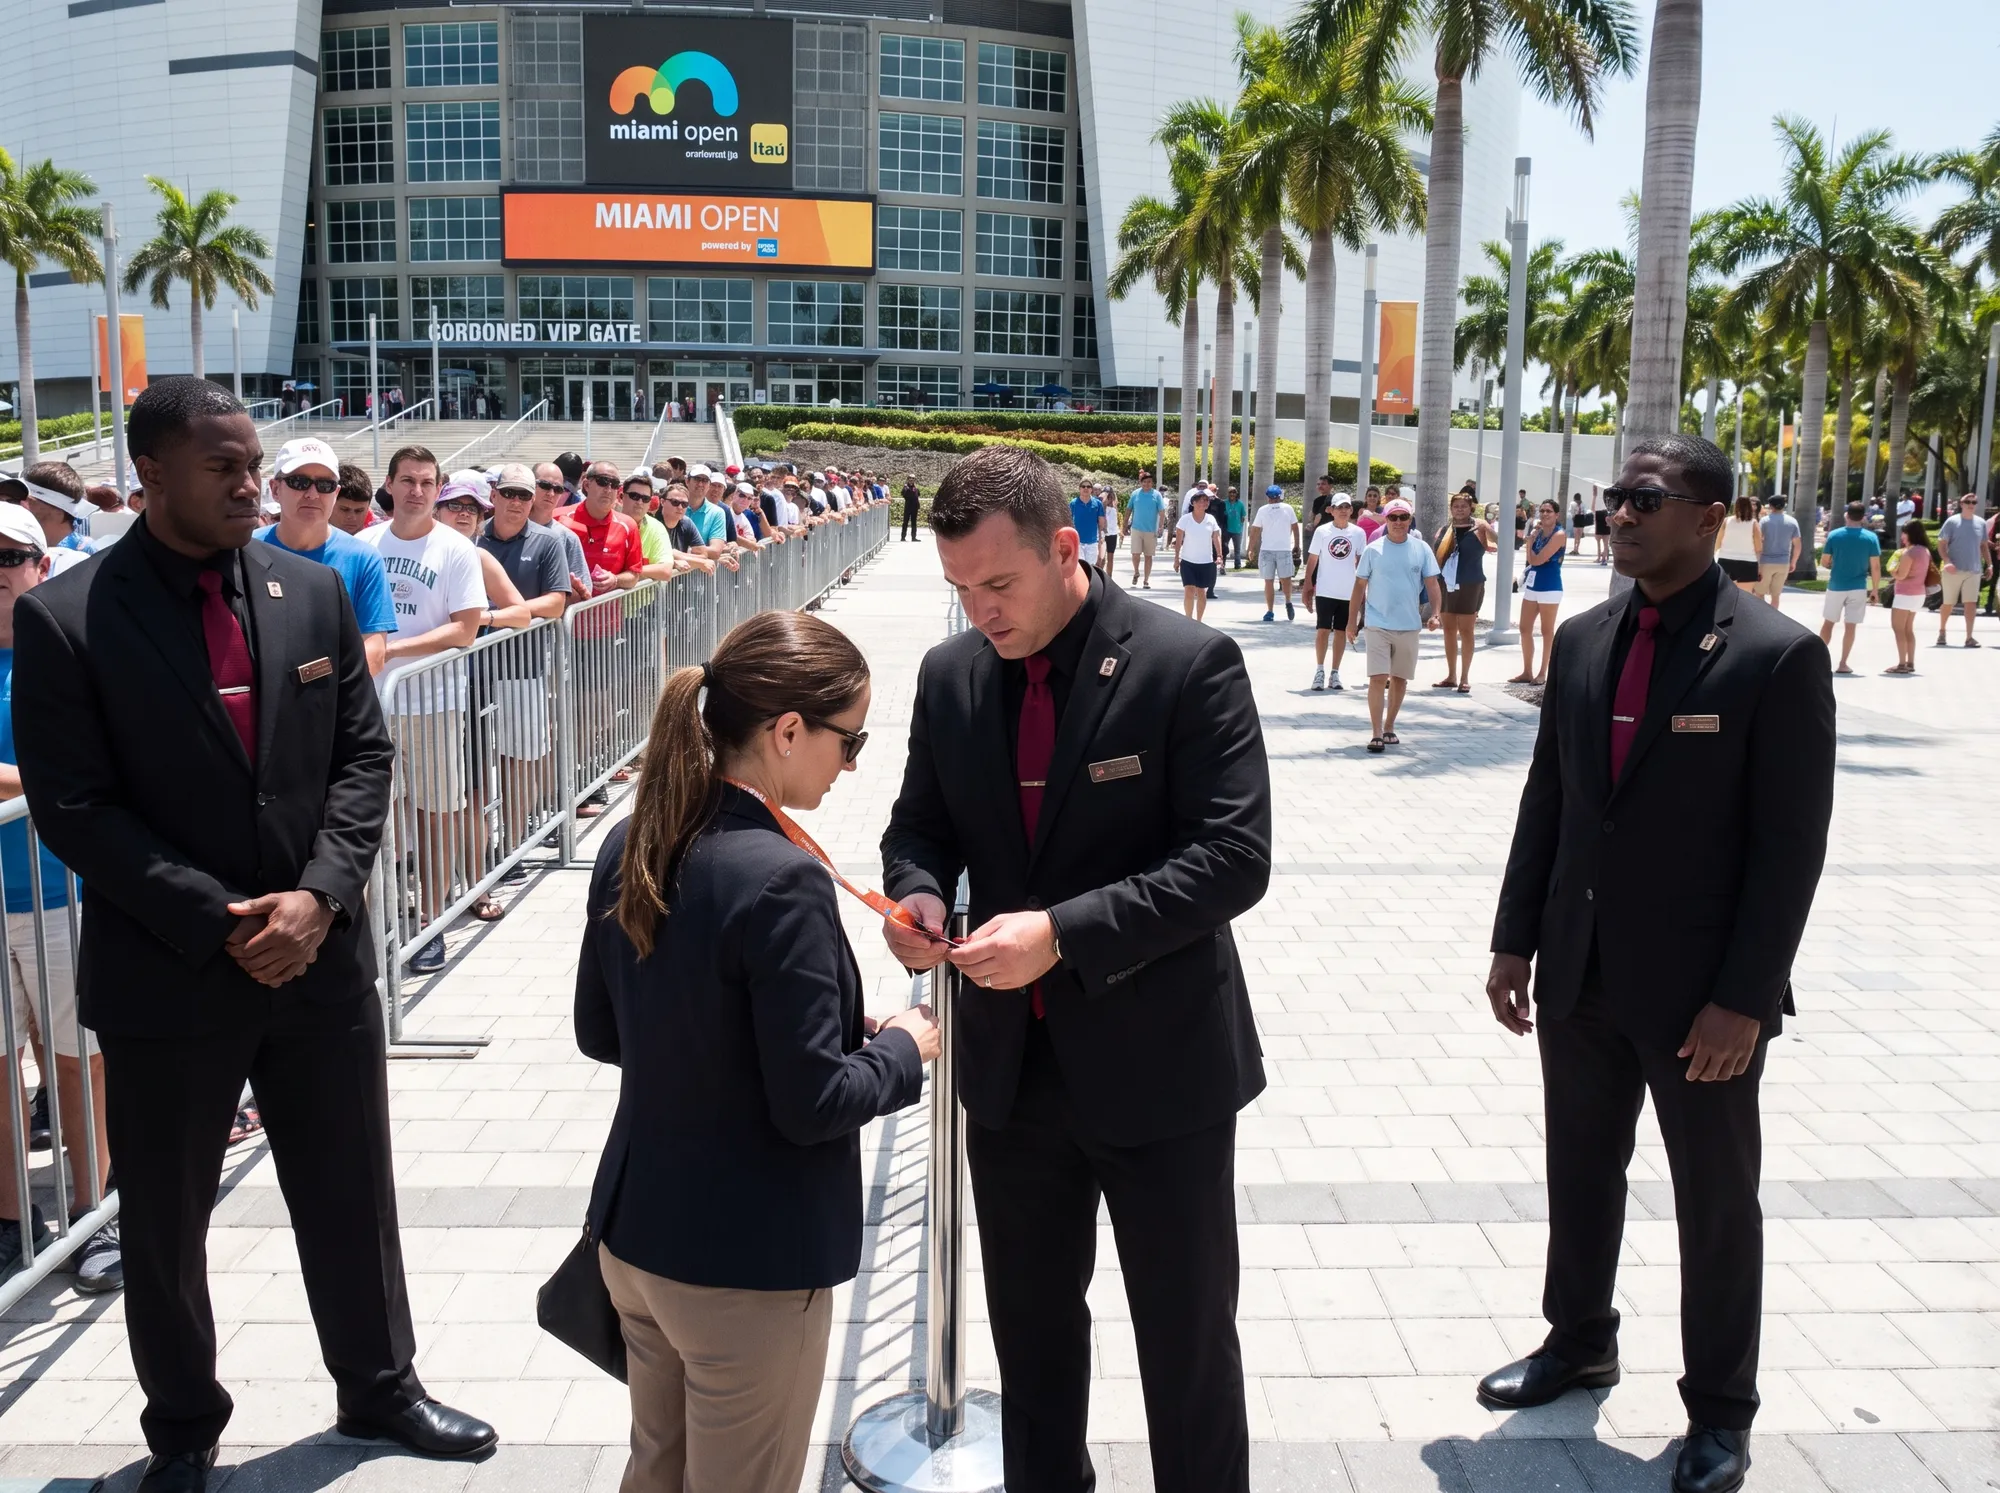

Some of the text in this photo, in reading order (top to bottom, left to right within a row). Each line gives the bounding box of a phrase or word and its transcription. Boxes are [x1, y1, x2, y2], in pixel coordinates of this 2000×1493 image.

[610, 119, 738, 145] miami open
[753, 142, 785, 156] Itaú
[595, 203, 779, 232] MIAMI OPEN
[701, 242, 739, 250] powered
[741, 242, 752, 251] by
[547, 323, 582, 341] VIP
[589, 324, 641, 342] GATE
